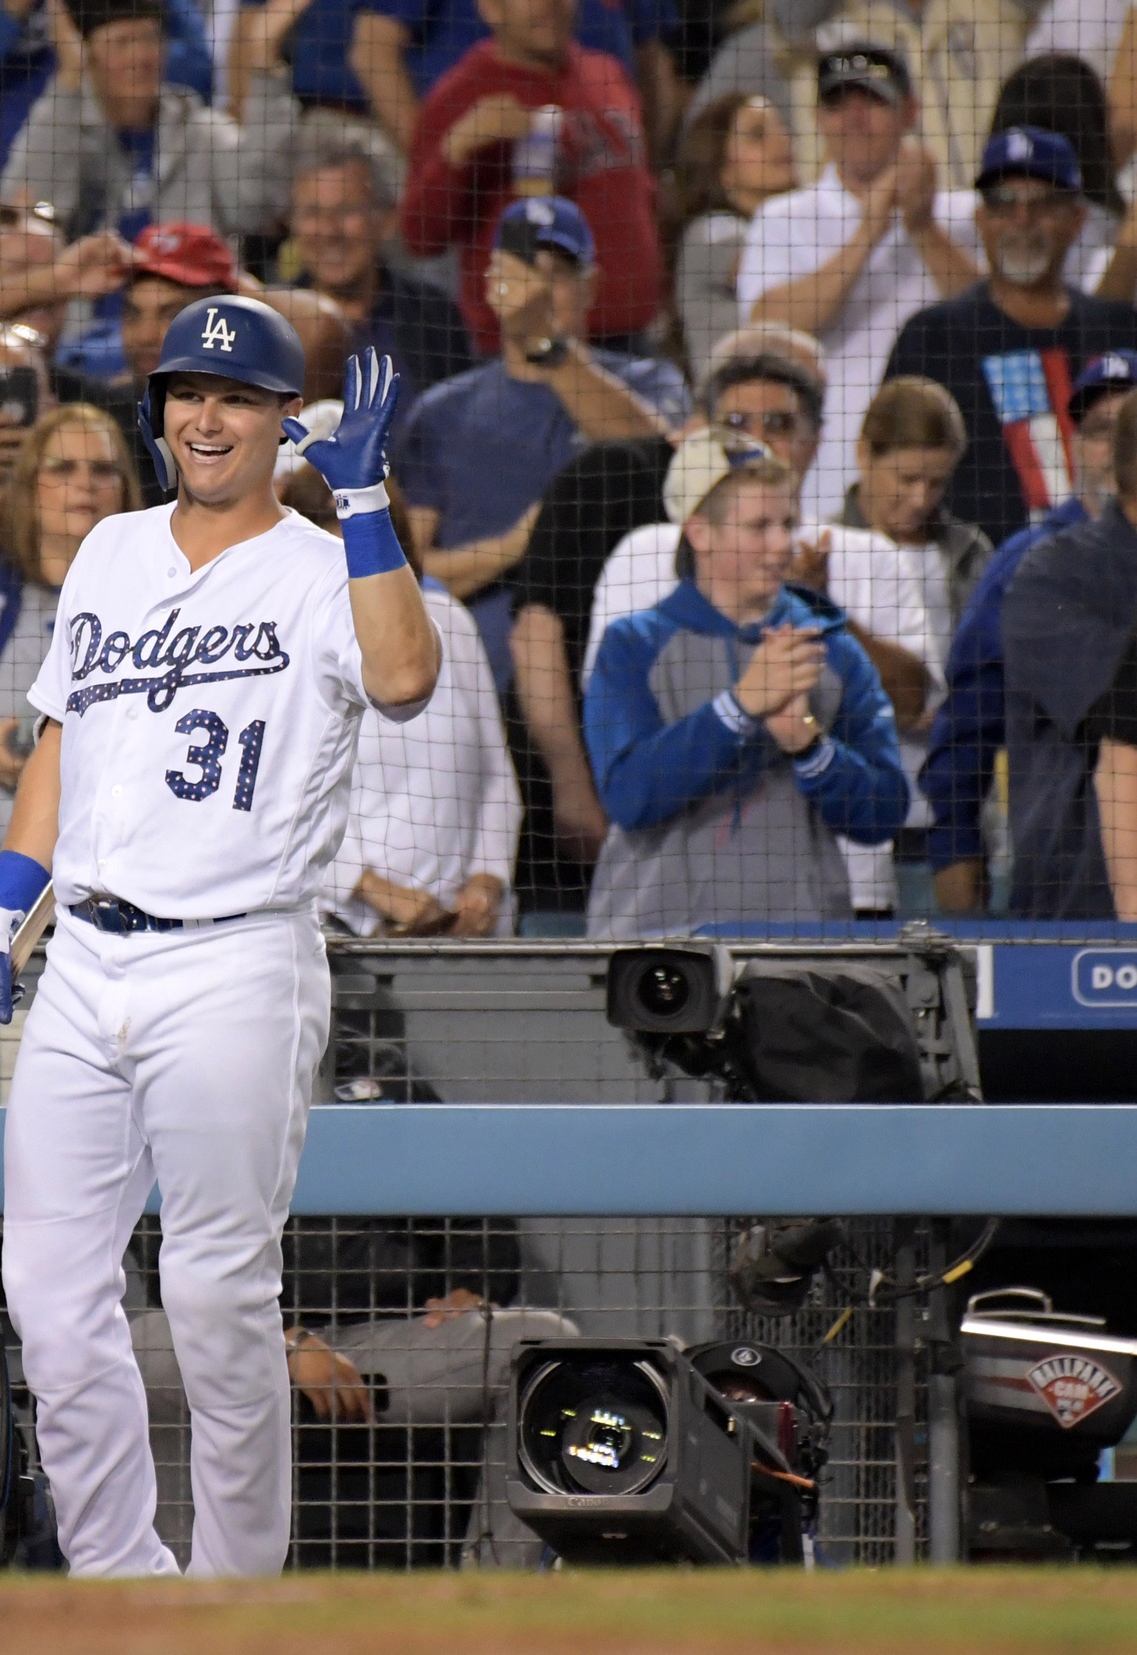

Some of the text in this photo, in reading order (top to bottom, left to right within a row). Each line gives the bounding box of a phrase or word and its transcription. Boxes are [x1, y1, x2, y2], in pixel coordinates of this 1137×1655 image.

[201, 308, 236, 352] LA
[66, 608, 290, 718] Dodgers
[164, 708, 267, 812] 31
[1092, 965, 1137, 990] DO
